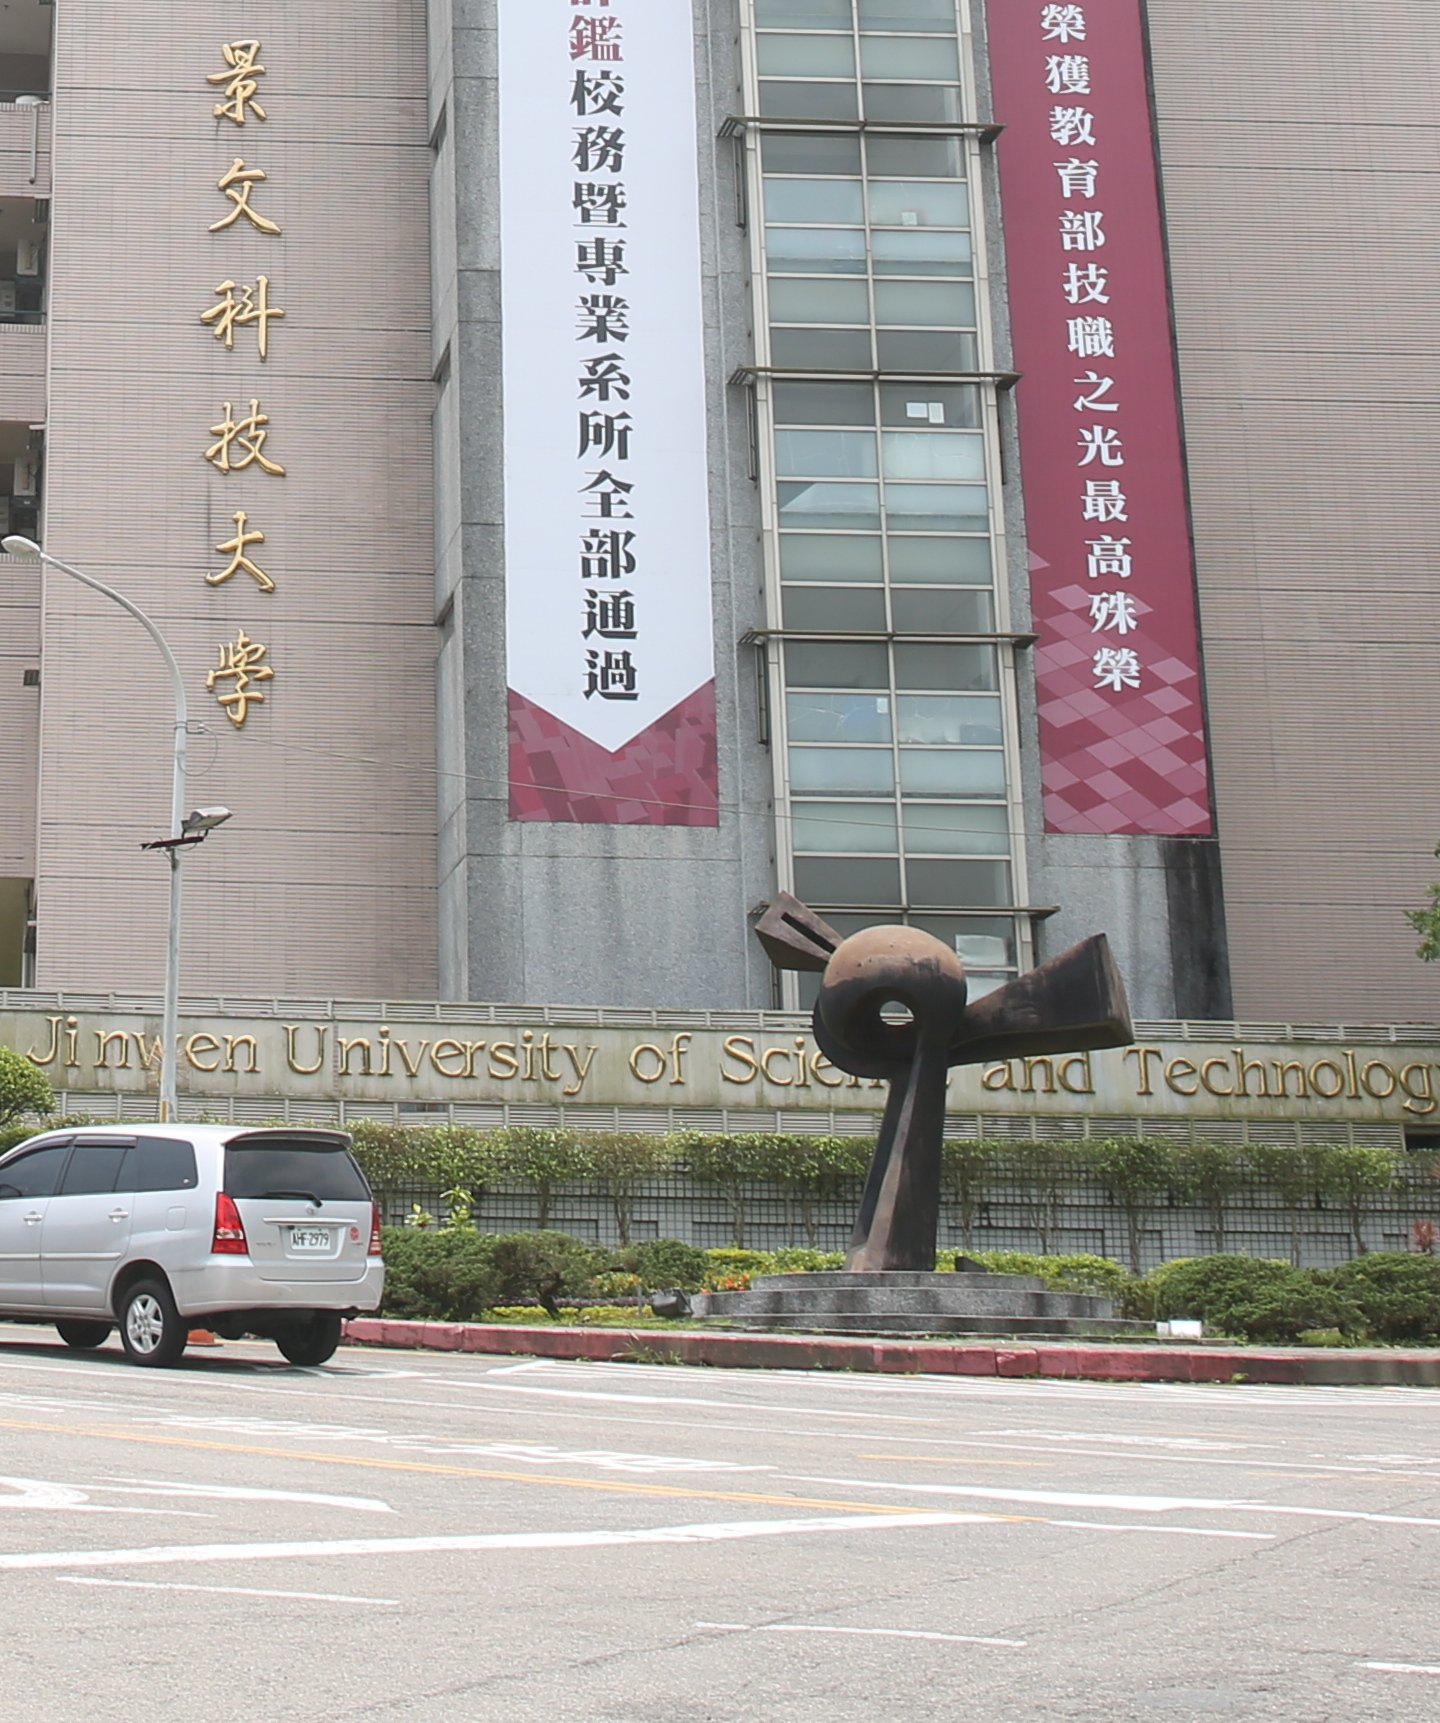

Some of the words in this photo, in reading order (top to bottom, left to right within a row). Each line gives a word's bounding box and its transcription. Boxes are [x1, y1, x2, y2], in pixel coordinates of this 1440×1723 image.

[26, 1015, 260, 1073] Jinwen
[282, 1024, 597, 1094] University
[628, 1032, 692, 1085] of
[292, 1232, 329, 1247] AHF-2979
